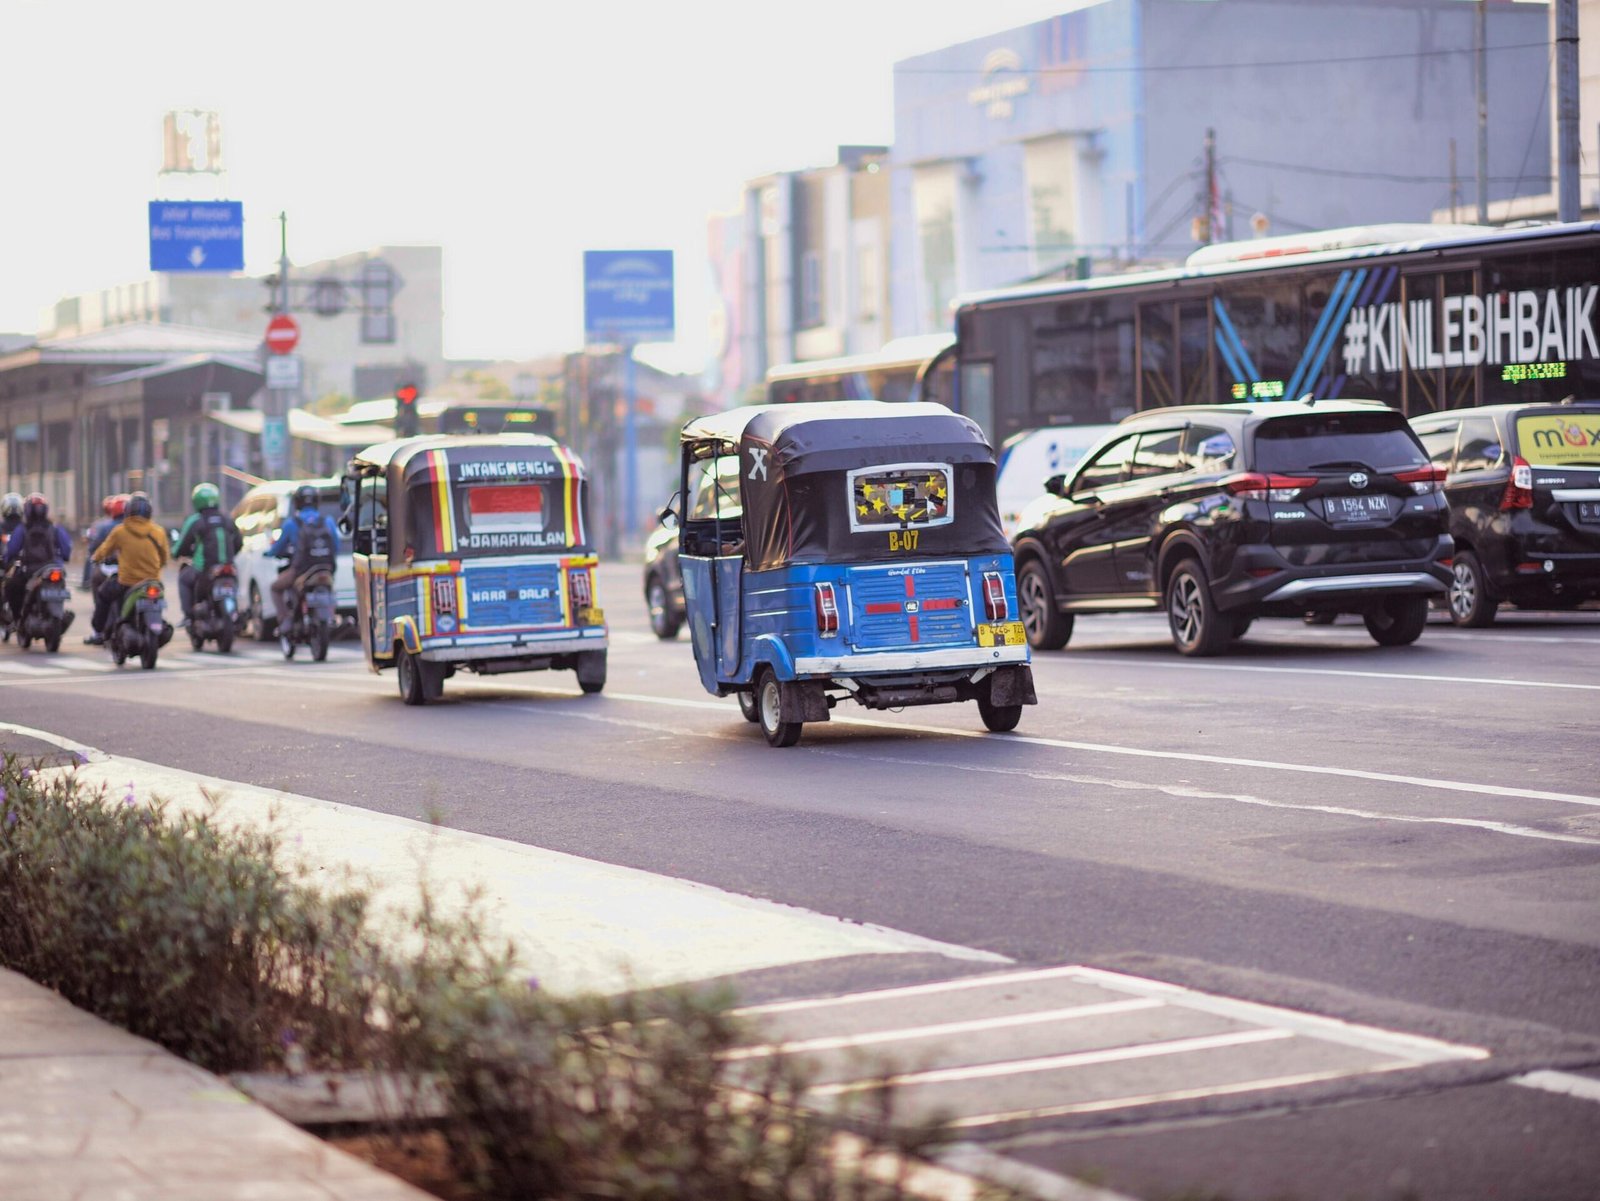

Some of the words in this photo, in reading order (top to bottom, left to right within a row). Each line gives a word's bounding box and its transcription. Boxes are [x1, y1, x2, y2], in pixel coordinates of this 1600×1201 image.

[1342, 285, 1600, 376] #KINILEBIHBAIK
[748, 447, 768, 482] X
[1327, 499, 1335, 514] B
[888, 530, 919, 551] B-07
